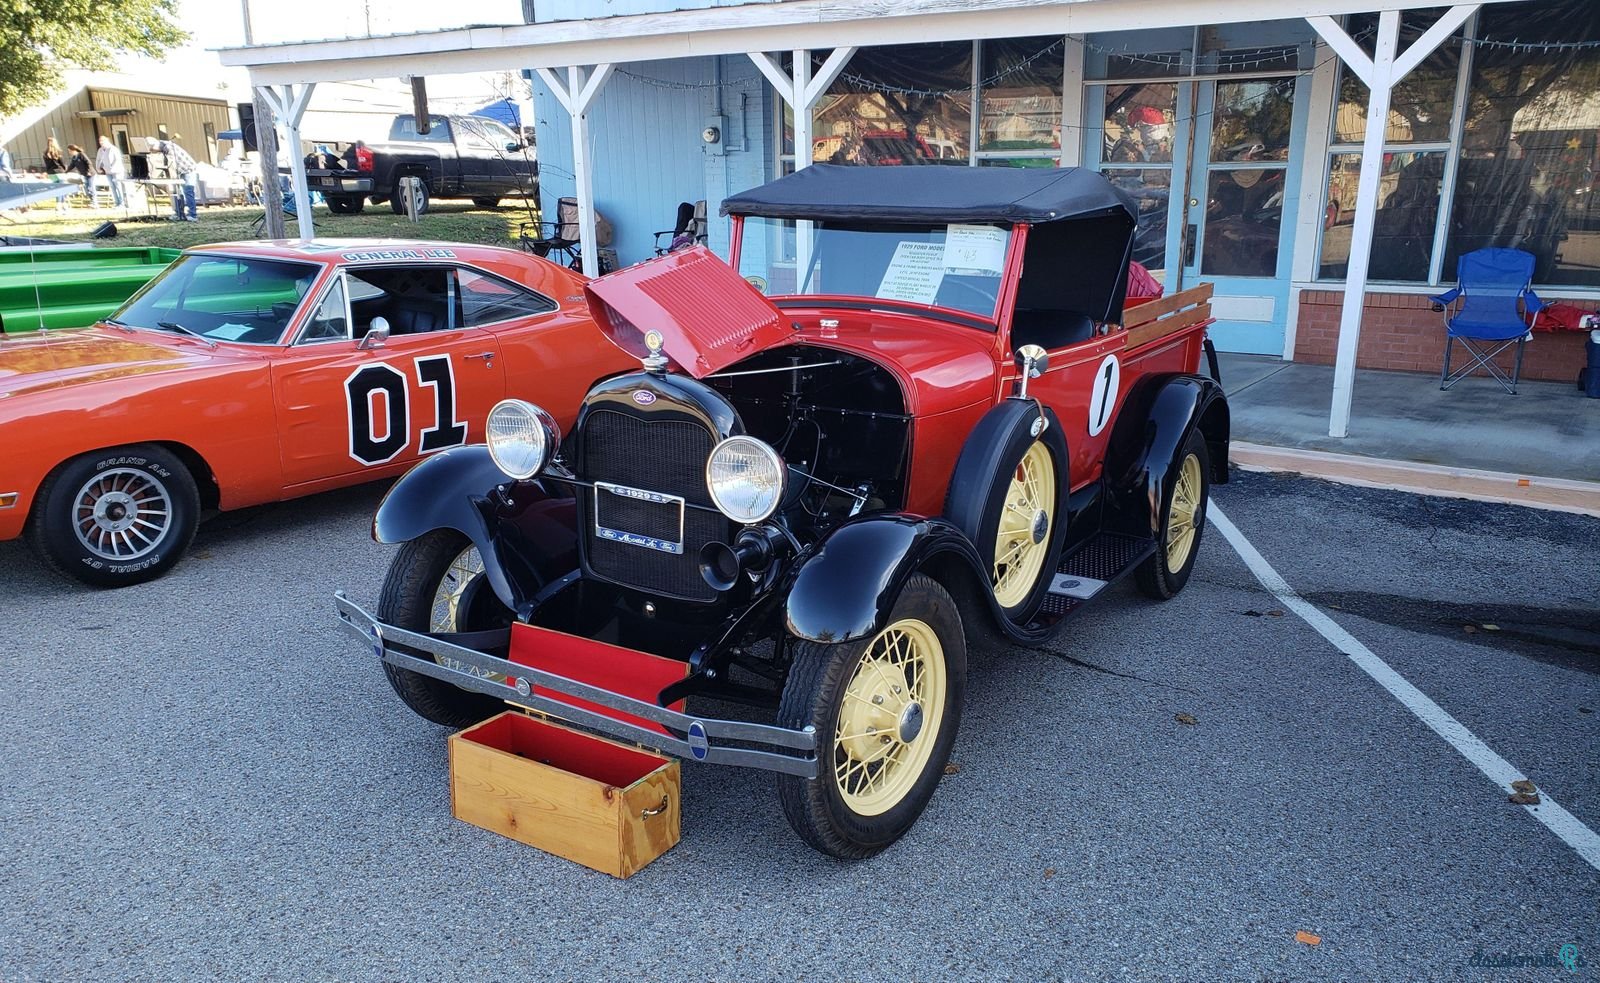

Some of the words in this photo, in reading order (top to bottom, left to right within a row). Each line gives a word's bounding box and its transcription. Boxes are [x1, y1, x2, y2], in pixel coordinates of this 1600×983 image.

[342, 250, 423, 262] GENERAL
[423, 248, 457, 259] LEE
[634, 391, 654, 403] Ford
[1096, 362, 1113, 429] 1
[344, 353, 468, 466] 01
[97, 457, 146, 470] GRAND
[148, 463, 171, 477] AM
[626, 490, 650, 499] 1929
[82, 557, 103, 569] GT
[109, 555, 160, 573] RADIAL
